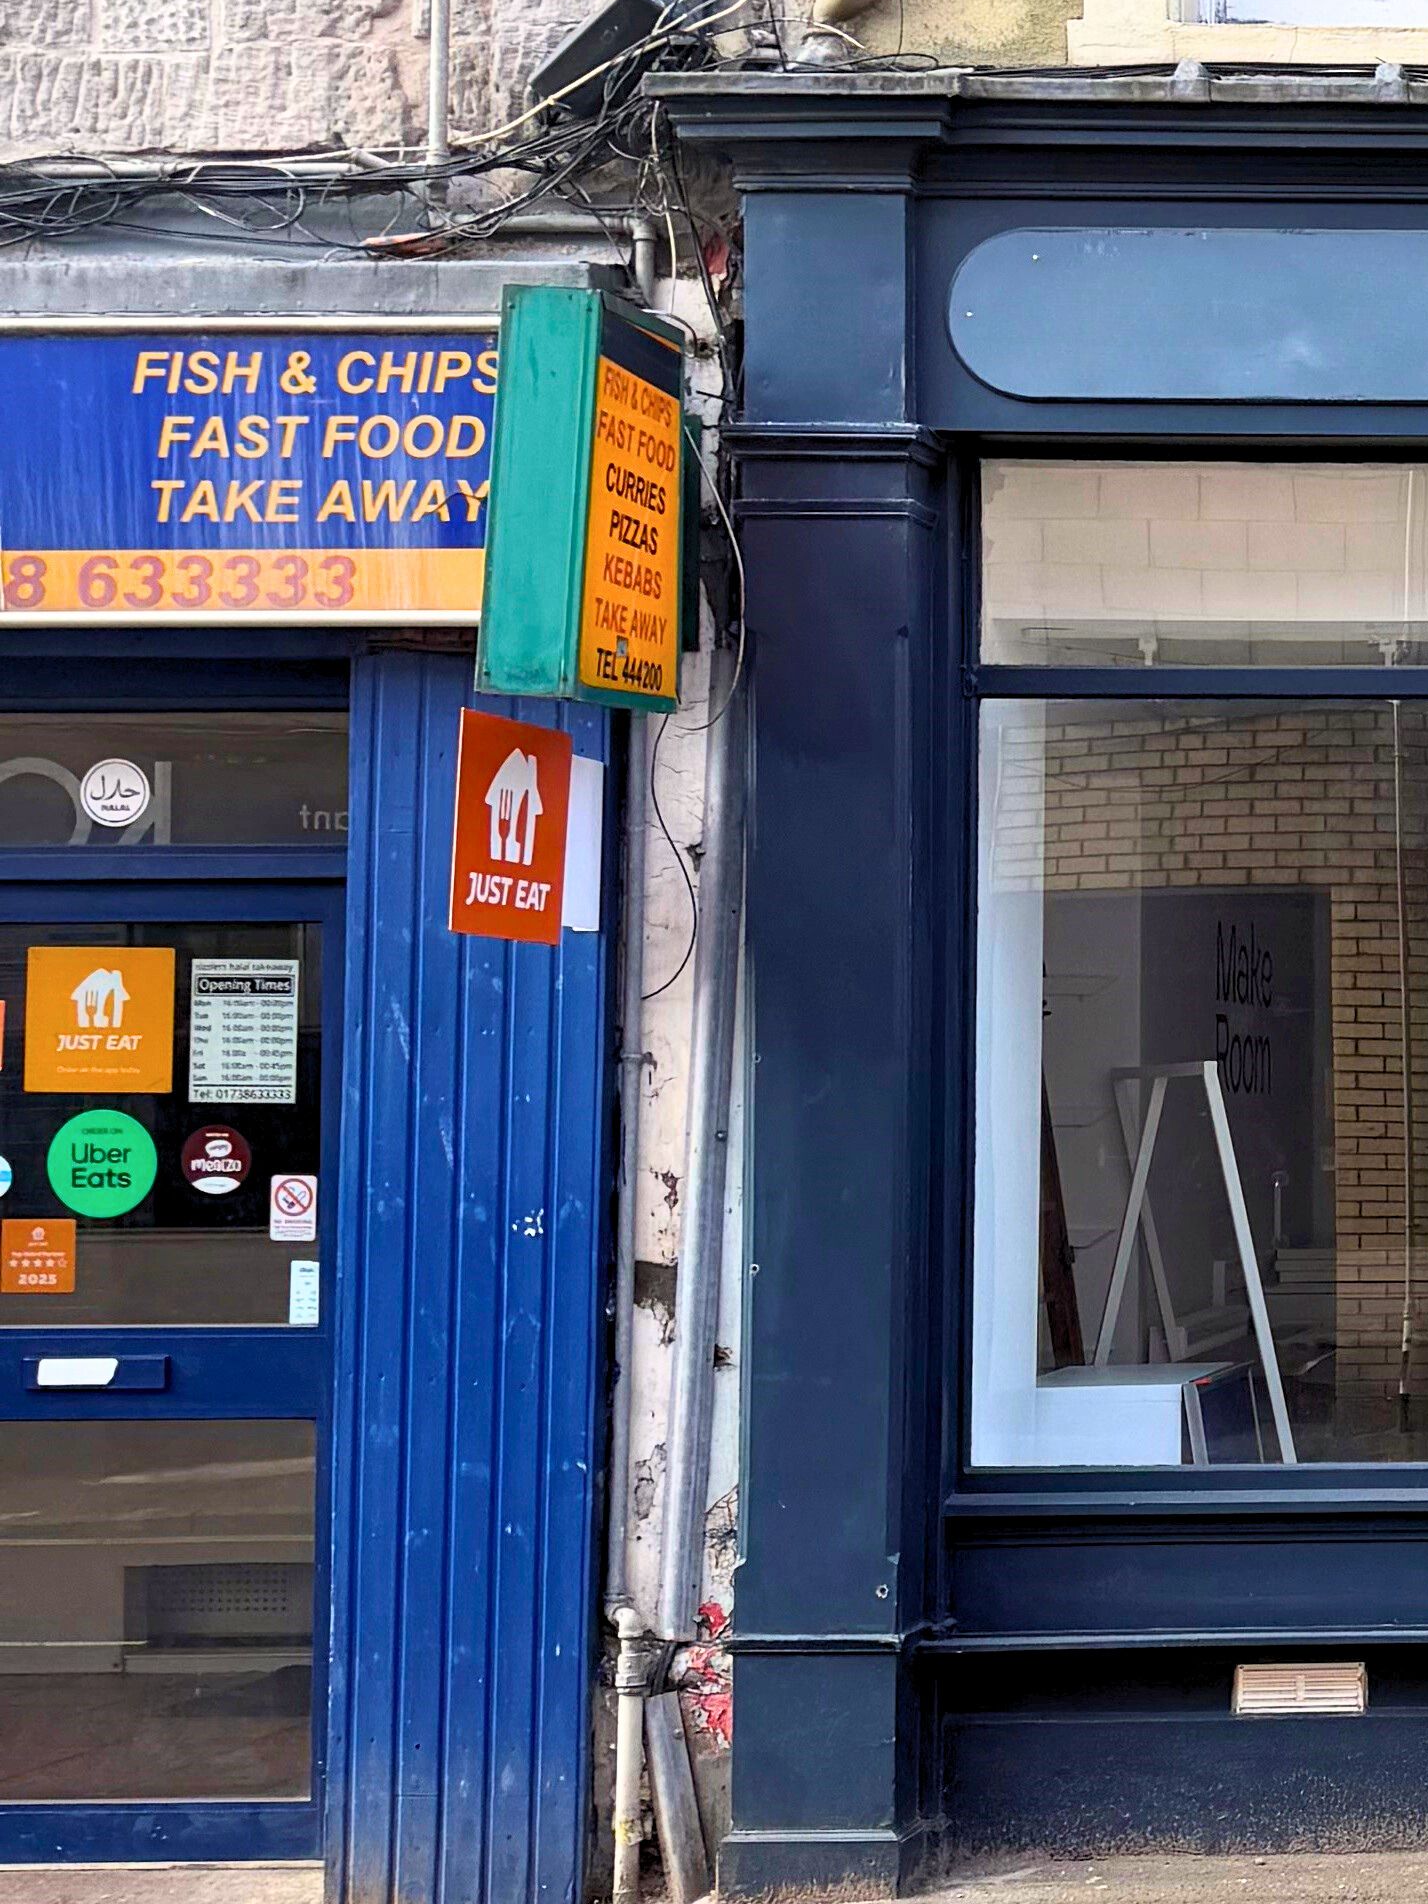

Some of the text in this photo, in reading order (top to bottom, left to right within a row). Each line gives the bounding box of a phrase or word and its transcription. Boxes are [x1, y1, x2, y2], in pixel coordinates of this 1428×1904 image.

[132, 350, 499, 395] FISH & CHIPS
[603, 366, 672, 428] FISH & CHIPS
[157, 415, 486, 459] FAST FOOD
[597, 409, 676, 472] FAST FOOD
[151, 479, 490, 523] TAKE AWAY
[605, 462, 667, 516] CURRIES
[610, 509, 658, 556] PIZZAS
[78, 555, 357, 608] 633333
[603, 552, 662, 600] KEBABS
[595, 597, 668, 646] TAKE AWAY
[596, 647, 663, 692] TEL 444200
[464, 871, 551, 912] JUST EAT
[199, 979, 290, 993] Opening Times
[1216, 920, 1273, 1008] Make
[56, 1034, 144, 1052] JUST EAT
[1216, 1014, 1271, 1094] Room
[71, 1143, 132, 1164] Uber
[71, 1167, 132, 1189] Eats
